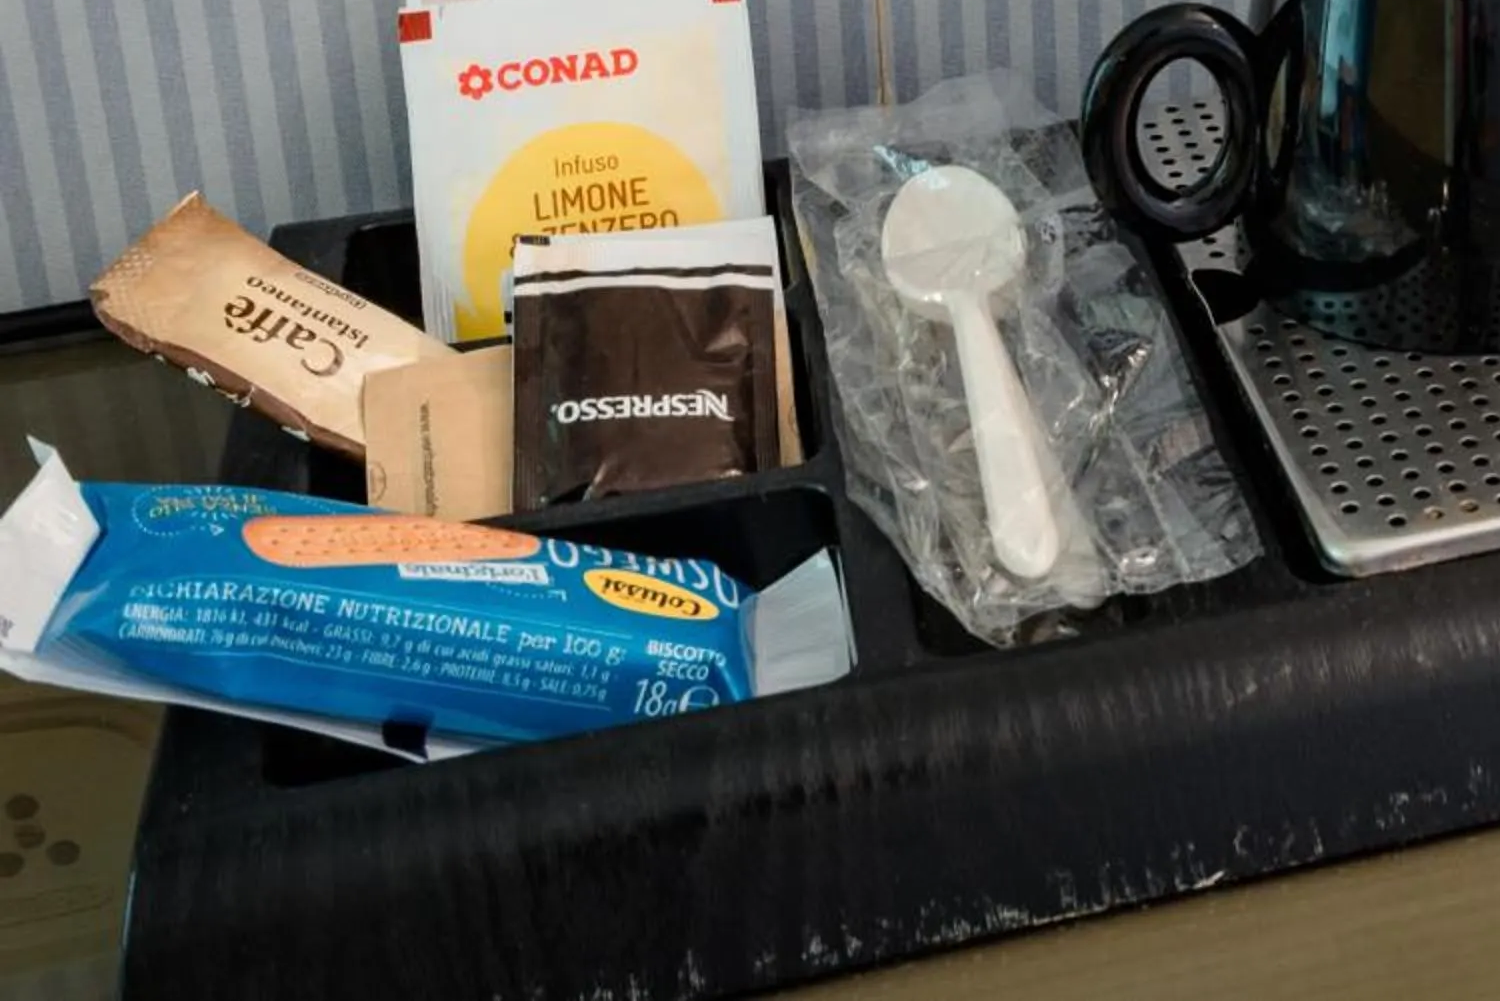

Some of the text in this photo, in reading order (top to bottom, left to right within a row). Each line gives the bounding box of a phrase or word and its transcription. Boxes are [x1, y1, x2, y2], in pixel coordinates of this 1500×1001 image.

[496, 48, 639, 92] CONAD
[554, 154, 620, 178] Infuso
[533, 176, 651, 222] LIMONE
[246, 276, 370, 349] Istantaneo
[224, 295, 345, 377] Caffè
[556, 388, 736, 424] NESPRESSO
[601, 576, 703, 617] Colussi
[337, 598, 512, 644] NUTRIZIONALE
[517, 631, 557, 653] per
[563, 632, 602, 658] 100
[646, 639, 726, 668] BISCOTTO
[656, 659, 709, 681] SECCO
